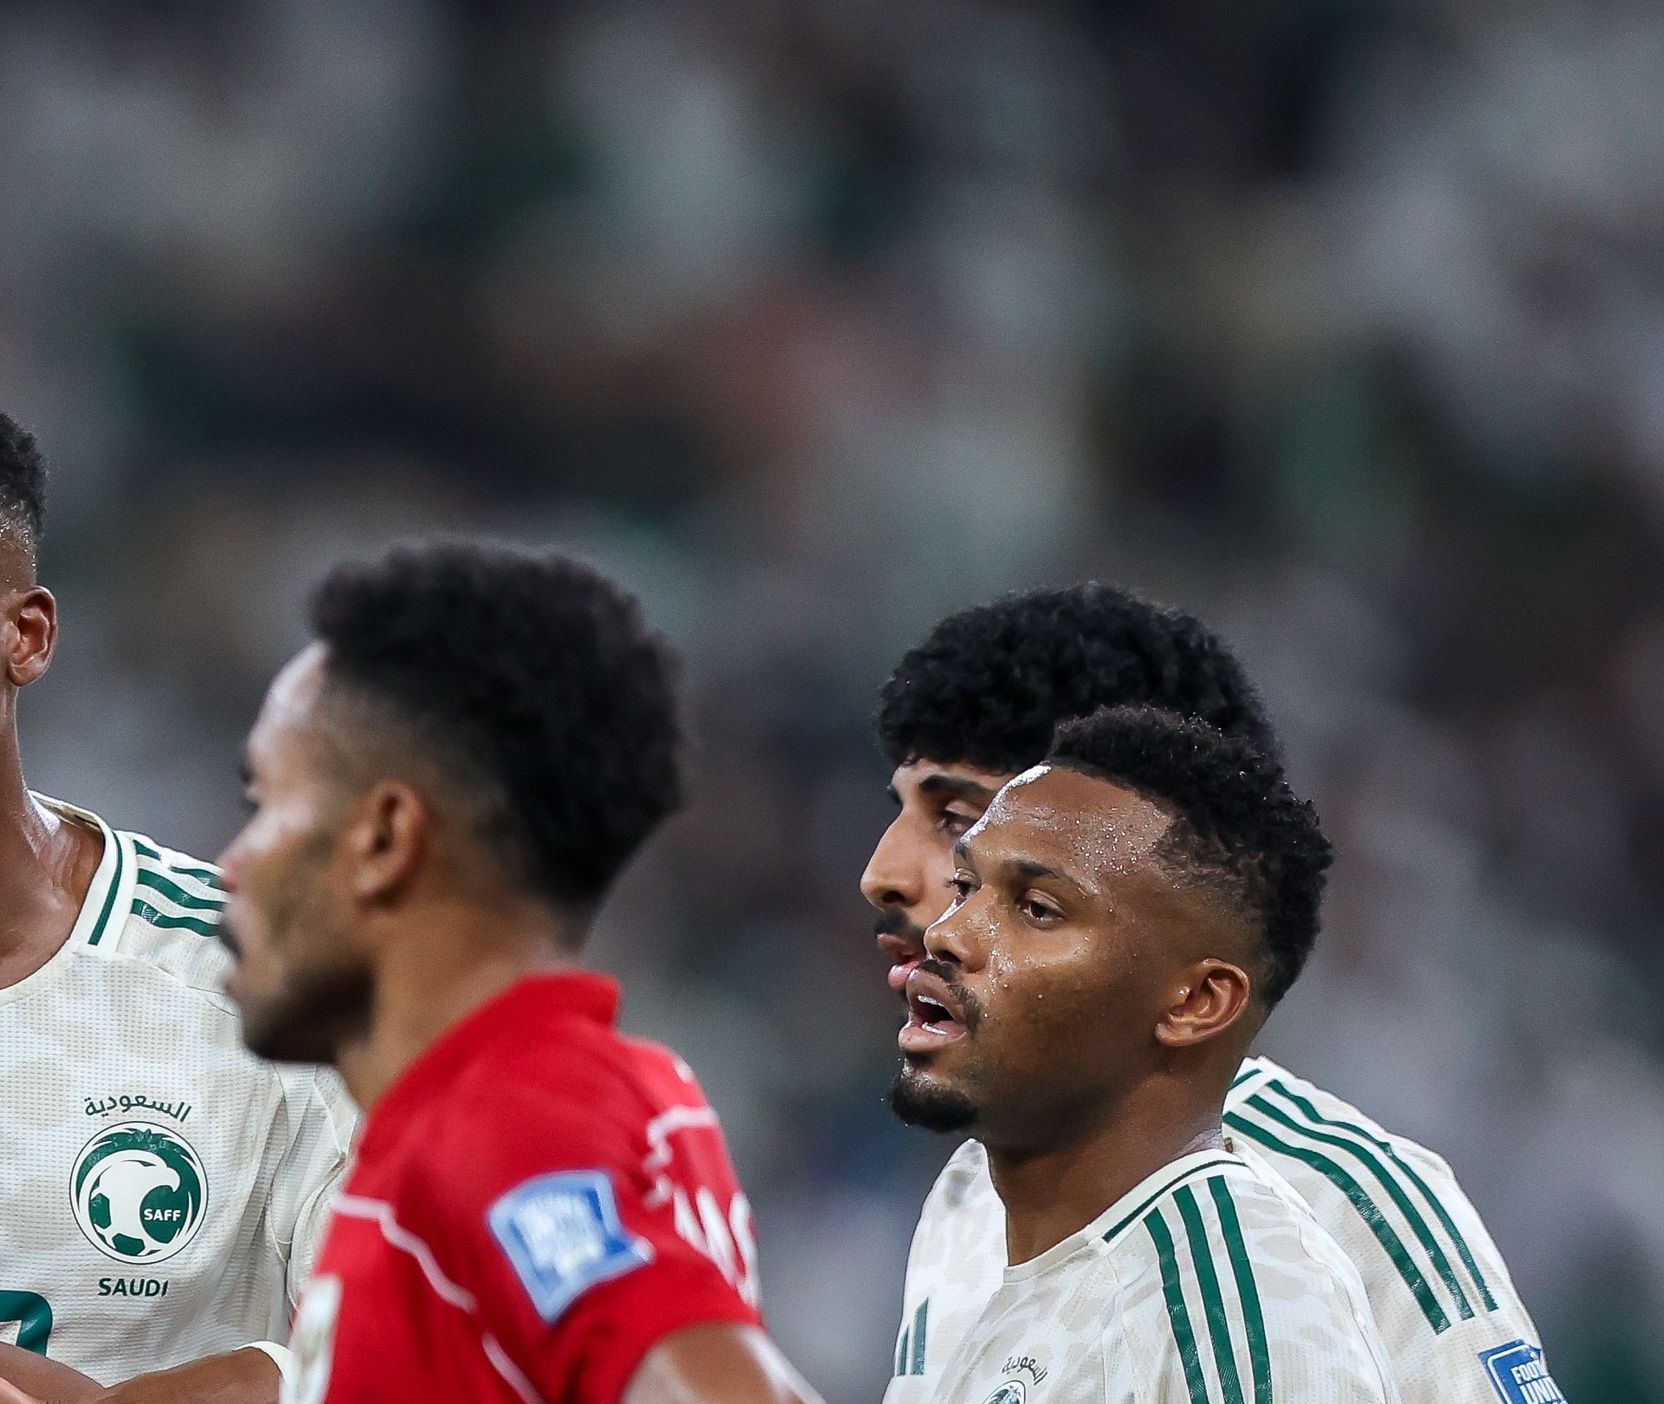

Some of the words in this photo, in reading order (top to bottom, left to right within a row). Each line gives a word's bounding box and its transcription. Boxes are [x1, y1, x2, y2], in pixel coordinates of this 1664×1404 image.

[84, 1094, 192, 1123] السعودية
[143, 1208, 182, 1222] SAFF
[97, 1277, 170, 1297] SAUDI
